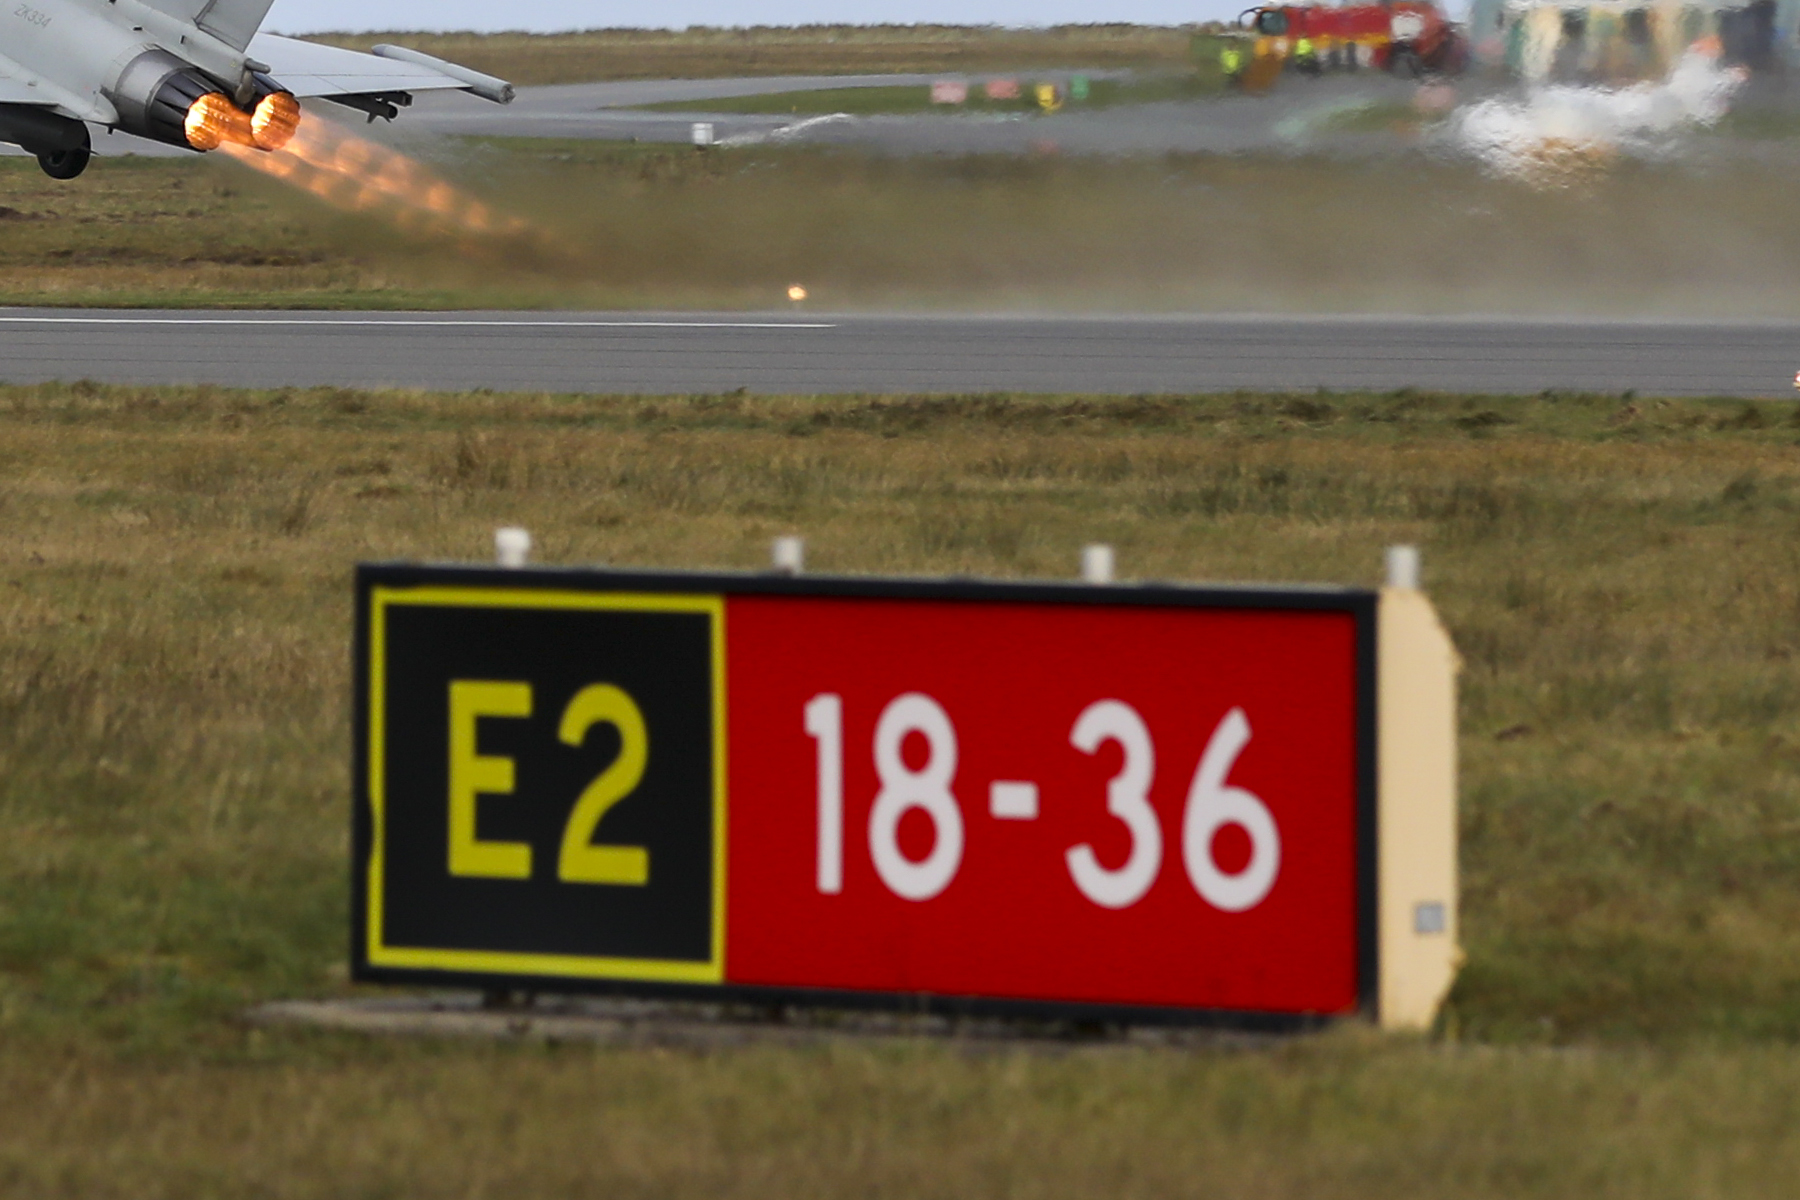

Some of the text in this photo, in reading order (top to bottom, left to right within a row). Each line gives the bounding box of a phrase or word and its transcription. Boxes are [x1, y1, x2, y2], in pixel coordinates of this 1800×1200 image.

[14, 3, 52, 27] ZK334
[448, 680, 1281, 911] E2 18-36
